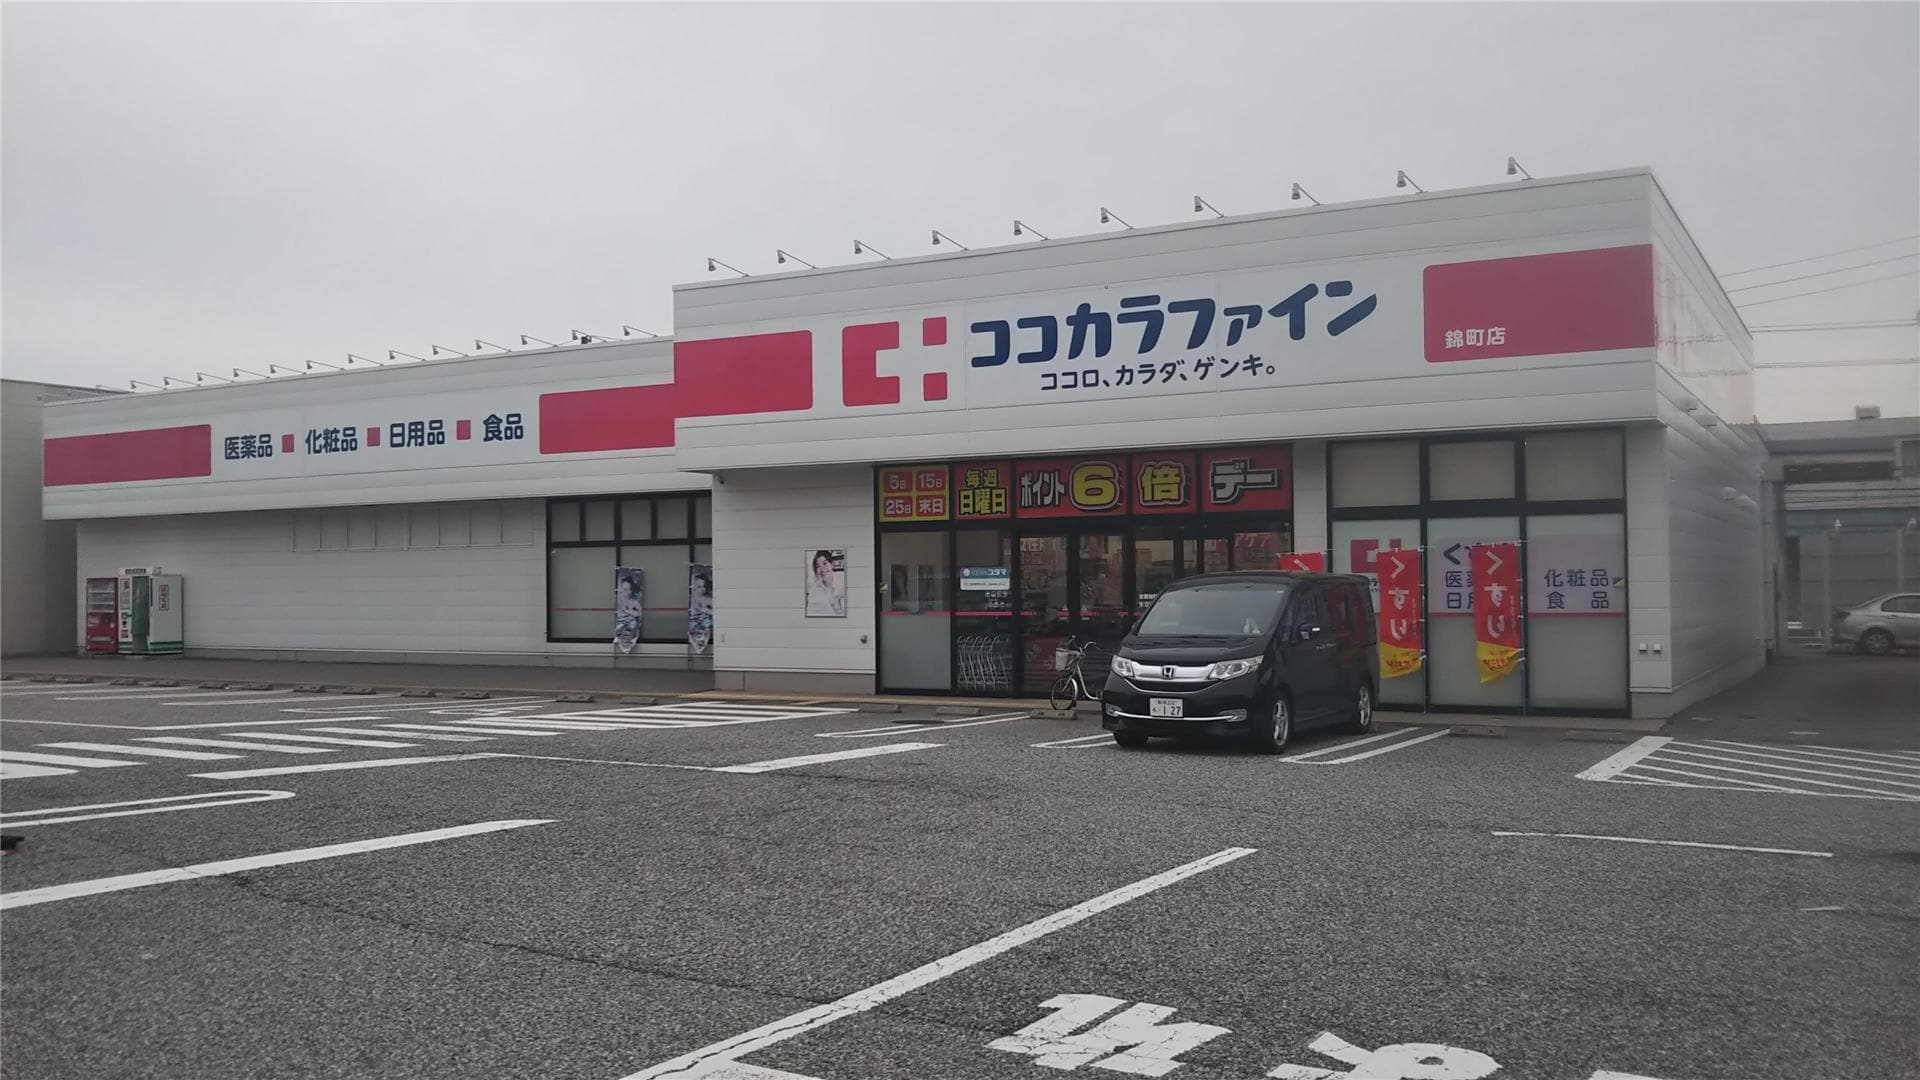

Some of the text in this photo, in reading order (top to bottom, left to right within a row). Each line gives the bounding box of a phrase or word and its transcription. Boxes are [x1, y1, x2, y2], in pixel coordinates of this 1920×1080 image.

[971, 283, 1377, 368] ココカラファイン
[1445, 326, 1506, 348] 錦町店
[1041, 355, 1276, 390] ココロ、カラダ、ゲンキ。
[224, 413, 524, 460] 医薬品 化粧品 日用品 食品
[918, 472, 942, 488] 15日
[886, 499, 911, 515] 25日
[959, 488, 1008, 515] 日曜日
[1544, 568, 1609, 588] 化粧品
